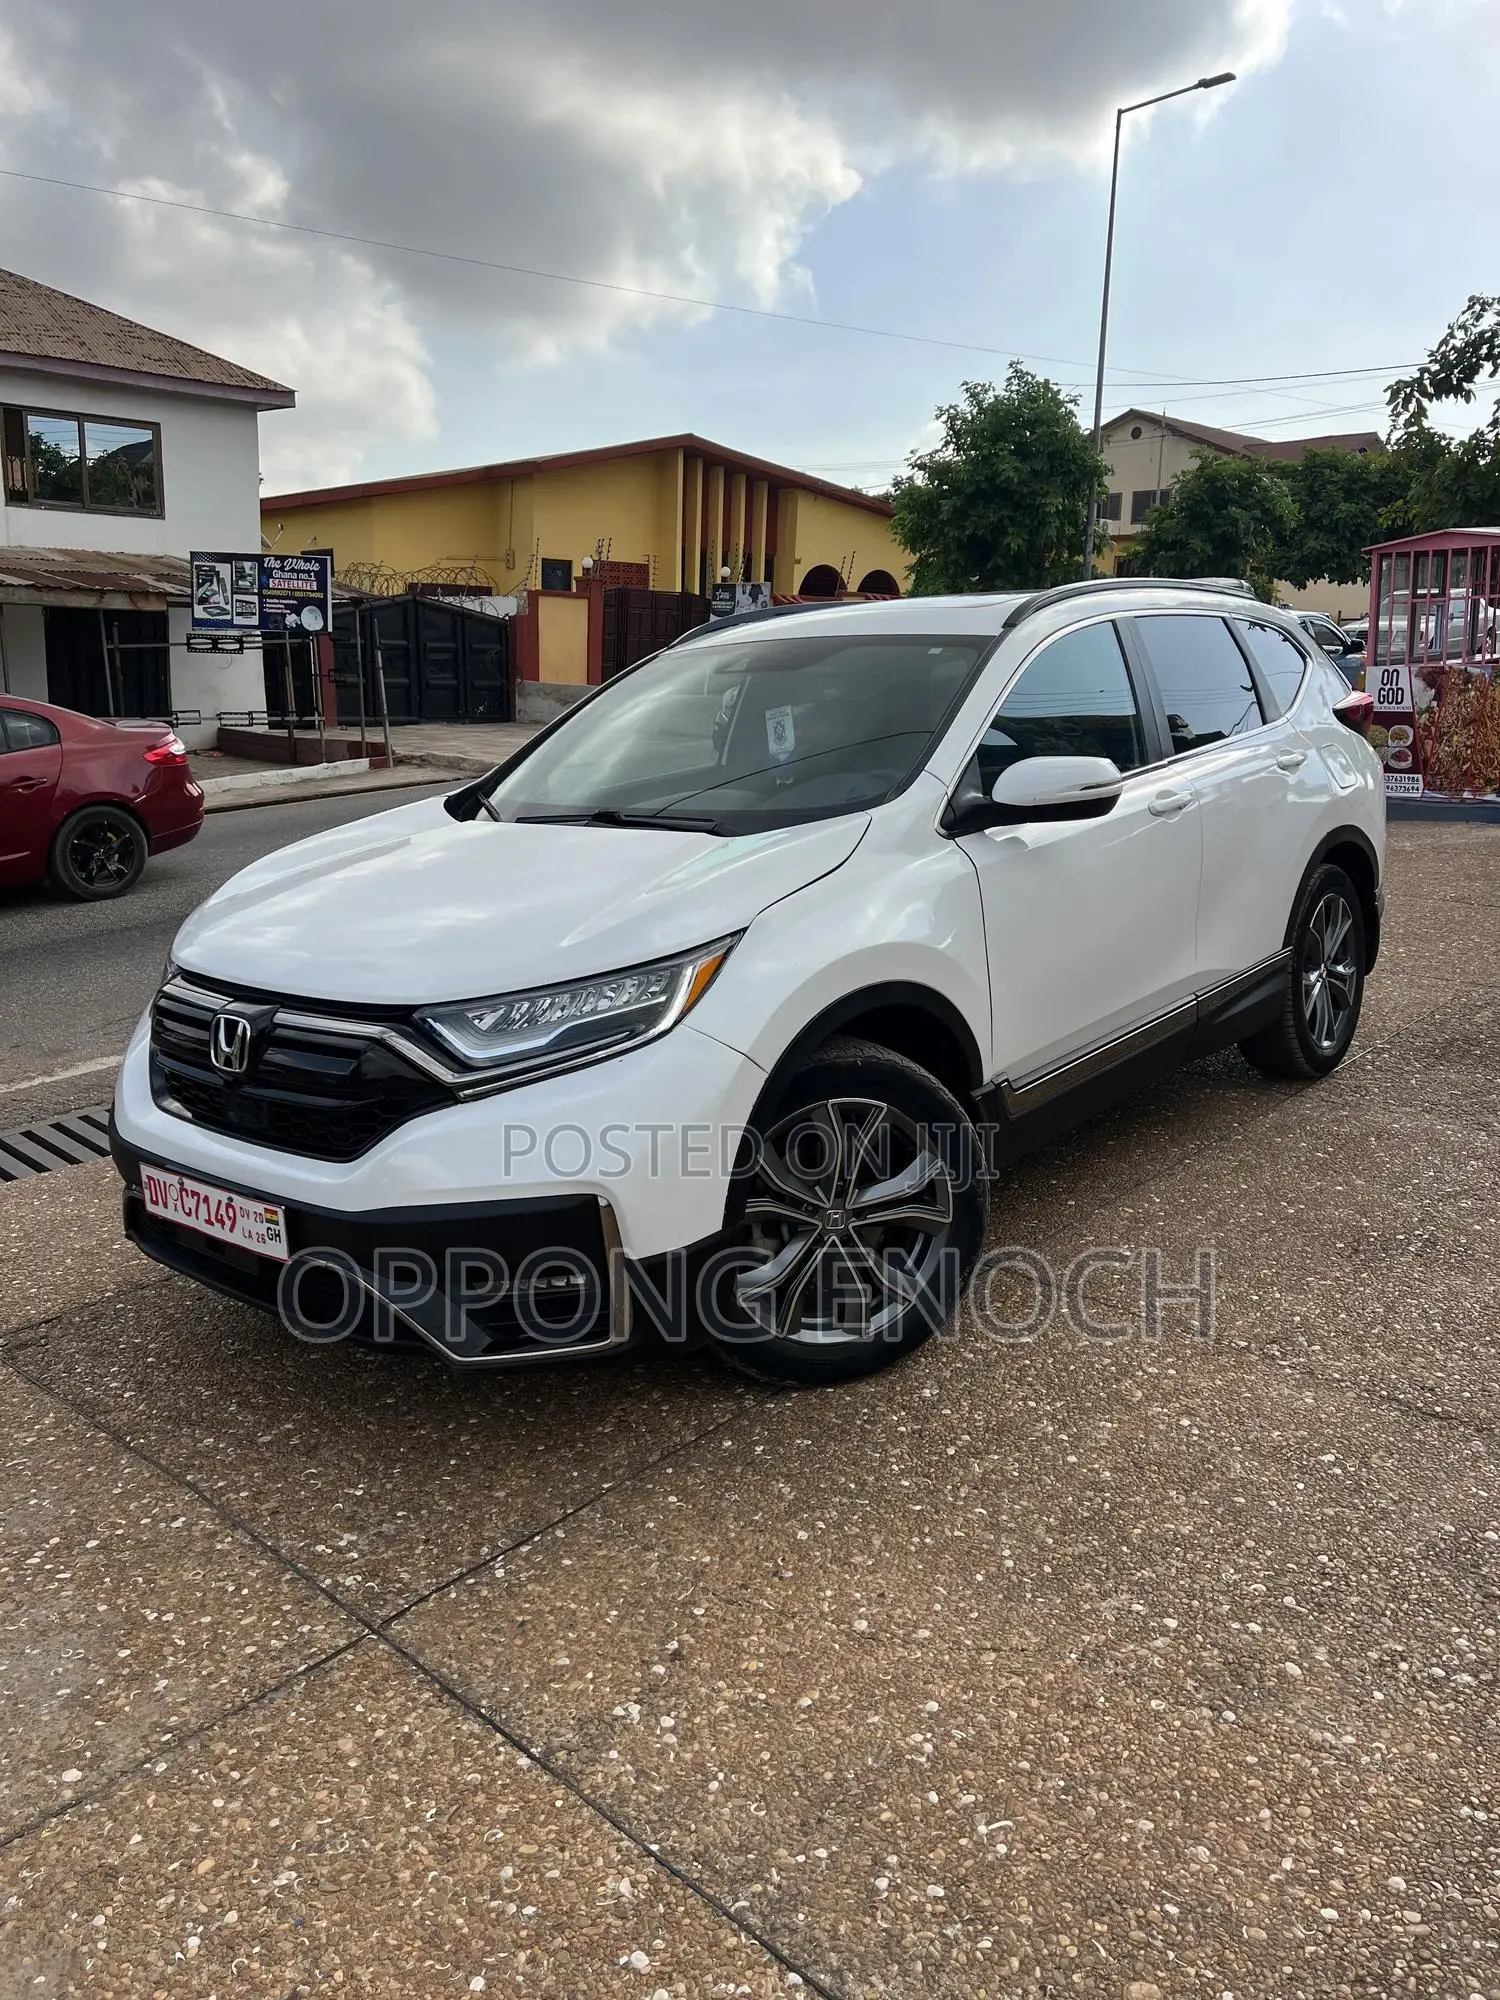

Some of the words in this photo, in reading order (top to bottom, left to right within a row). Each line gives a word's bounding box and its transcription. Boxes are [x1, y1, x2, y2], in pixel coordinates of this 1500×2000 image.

[263, 556, 282, 568] The
[283, 558, 320, 571] Whole
[272, 569, 298, 579] Ghana
[298, 572, 316, 581] no.1
[271, 580, 315, 590] SATELLITE
[1377, 687, 1405, 705] GOD
[1384, 775, 1420, 783] 37631986
[1386, 784, 1420, 792] 96373694
[146, 1174, 168, 1209] DV
[179, 1186, 237, 1233] C7149
[239, 1206, 250, 1220] DV
[253, 1210, 264, 1224] 20
[242, 1226, 253, 1241] LA
[256, 1231, 267, 1245] 26
[266, 1226, 282, 1244] GH
